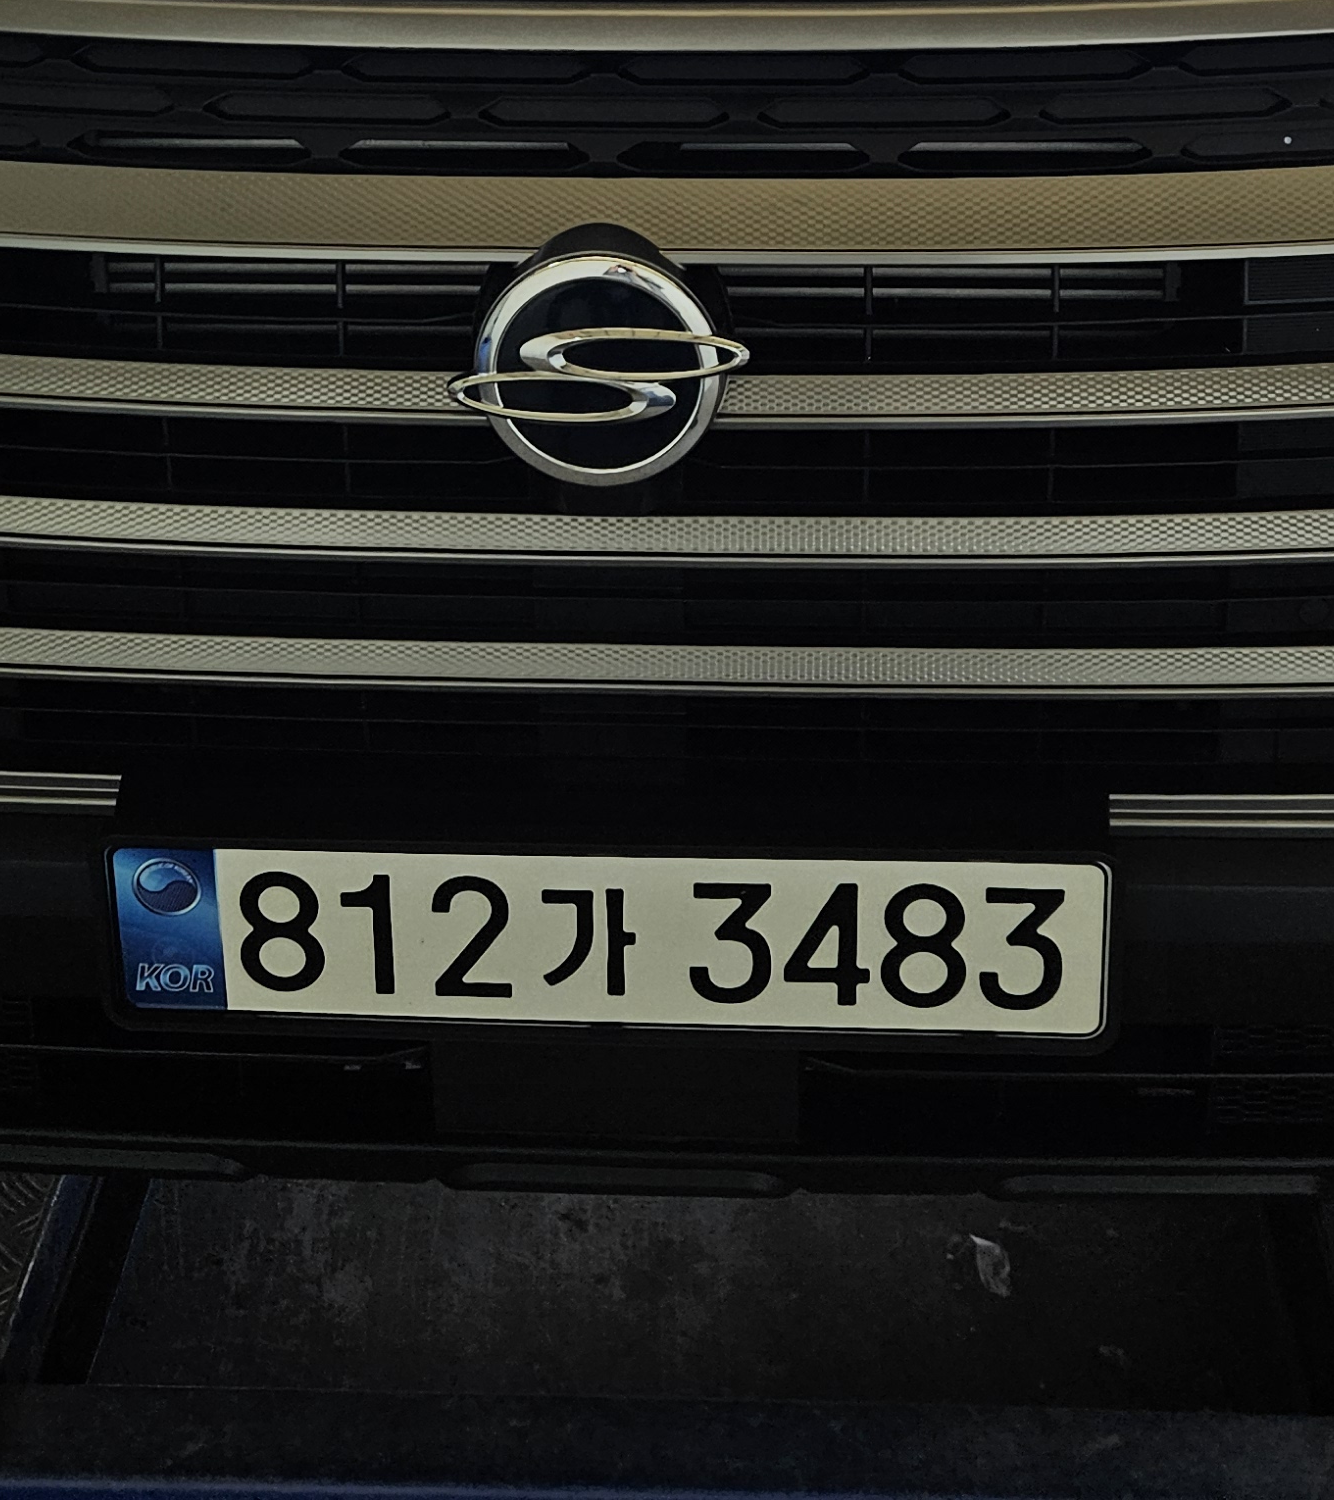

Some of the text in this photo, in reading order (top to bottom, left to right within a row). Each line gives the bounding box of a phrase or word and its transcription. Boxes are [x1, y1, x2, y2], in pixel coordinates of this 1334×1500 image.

[135, 962, 215, 994] KOR
[238, 870, 1067, 1011] 812가 3483
